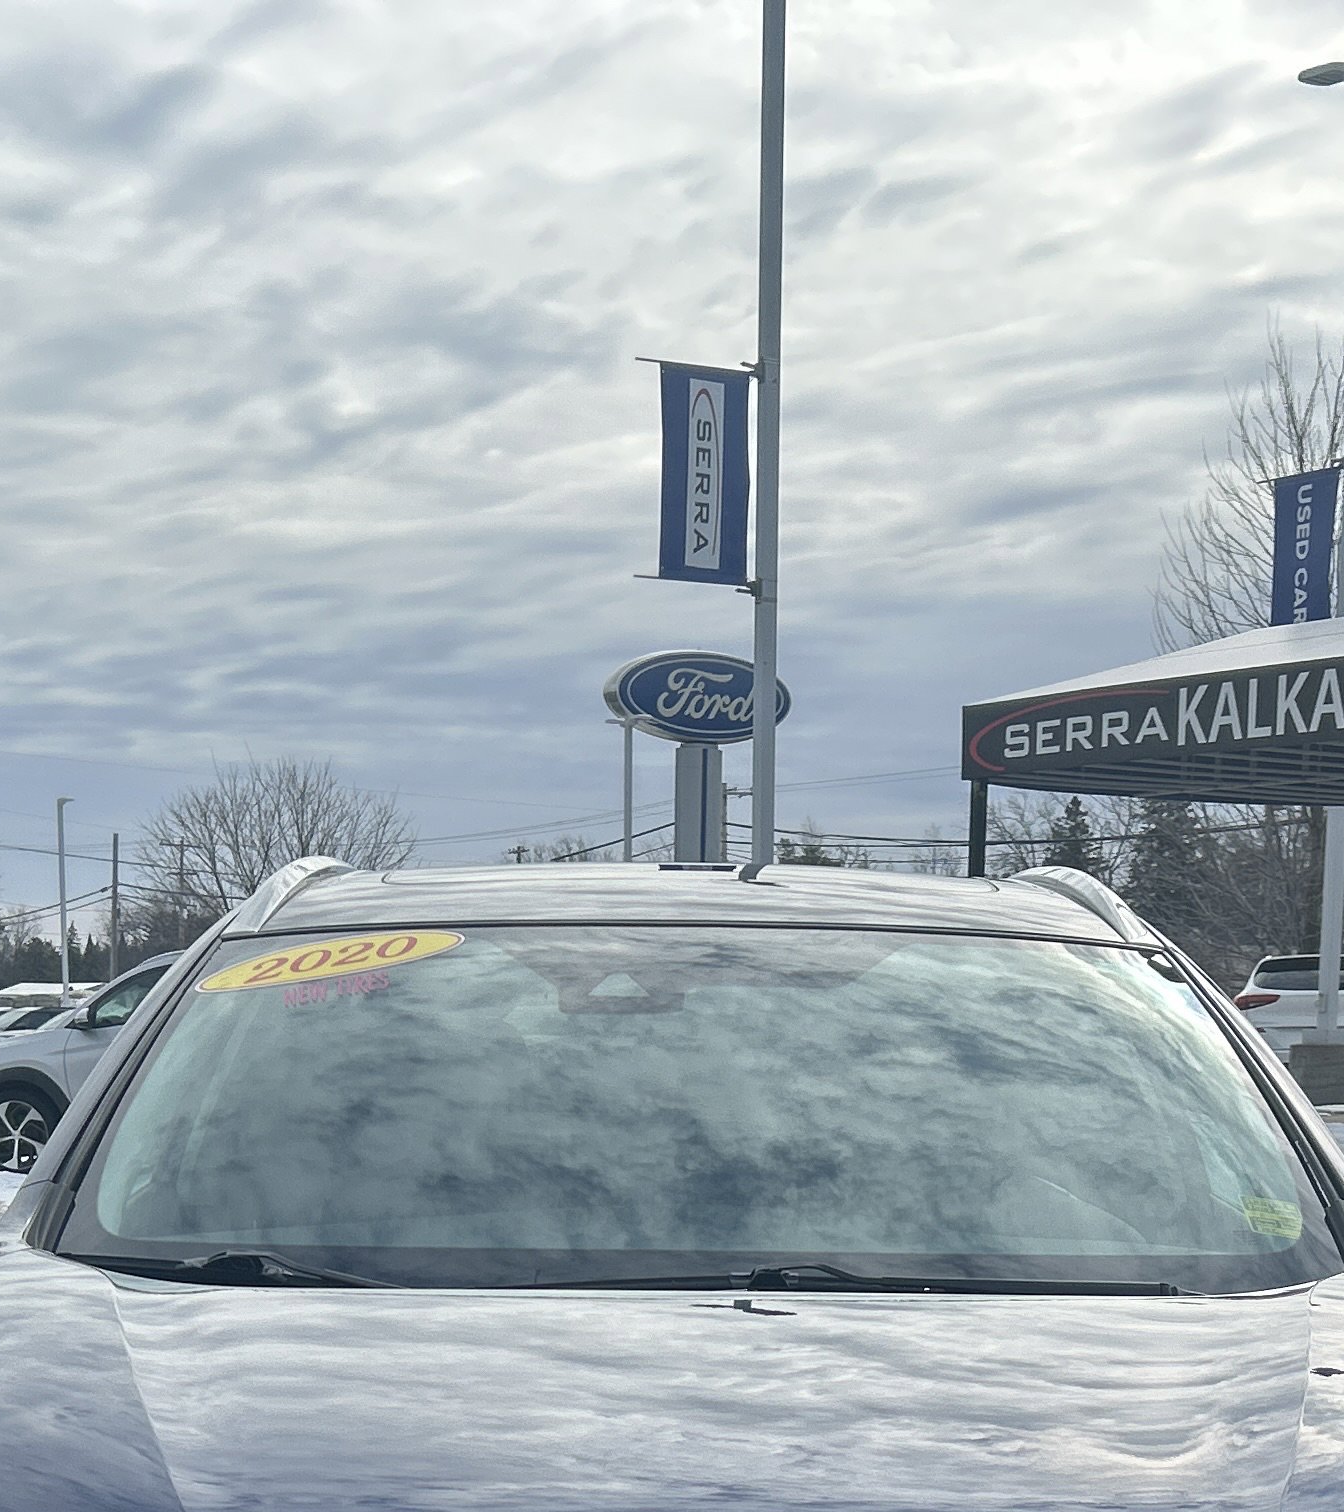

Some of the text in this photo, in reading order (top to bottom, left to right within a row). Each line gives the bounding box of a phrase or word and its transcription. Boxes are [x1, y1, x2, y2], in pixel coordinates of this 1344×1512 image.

[692, 418, 712, 554] SERRA
[1293, 483, 1313, 624] USED CAR
[1003, 706, 1170, 759] SERRA
[243, 935, 419, 985] 2020
[283, 971, 391, 1008] NEW TIRES
